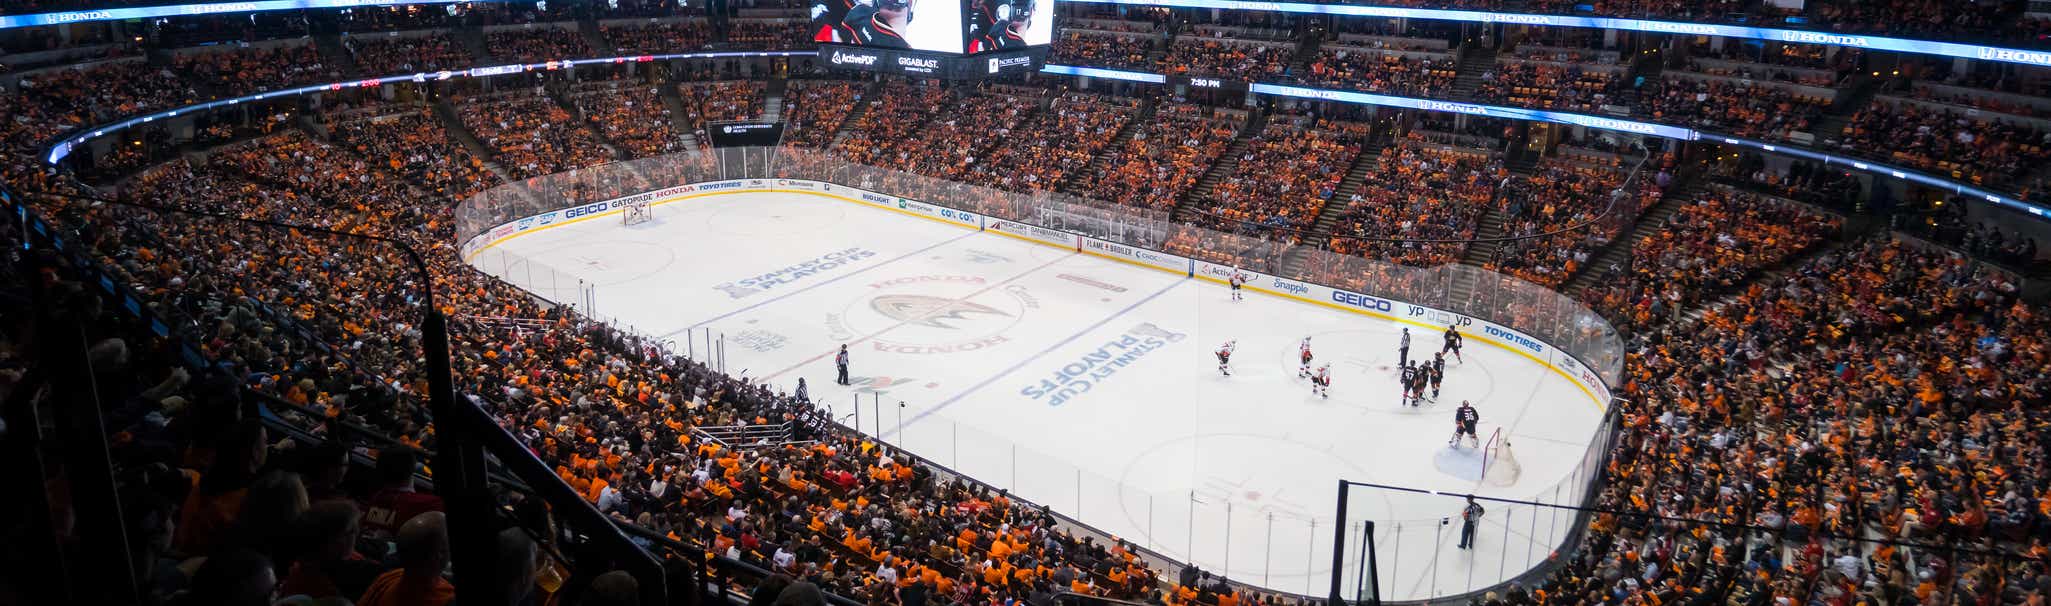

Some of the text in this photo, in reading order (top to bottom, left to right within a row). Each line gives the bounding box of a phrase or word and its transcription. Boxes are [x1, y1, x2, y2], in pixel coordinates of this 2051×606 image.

[59, 11, 112, 21] HONDA
[1495, 14, 1550, 24] HONDA
[1653, 22, 1717, 33] HONDA
[1800, 33, 1868, 46] HONDA
[1208, 79, 1220, 88] PM
[1432, 101, 1489, 114] HONDA
[1594, 120, 1657, 133] HONDA
[656, 186, 695, 198] HONDA
[874, 195, 889, 204] LIGHT
[565, 202, 607, 219] GEICO
[1087, 239, 1132, 255] FLAME BROILER
[739, 247, 860, 286] STANLEY CUP
[758, 250, 876, 289] PLAYOFFS
[1273, 278, 1309, 294] Snapple
[1332, 290, 1392, 312] GEICO
[1408, 304, 1425, 318] yp
[1455, 314, 1472, 327] yp
[873, 336, 1008, 354] HONDA
[1484, 325, 1543, 352] TOYO TIRES
[1021, 334, 1139, 400] PLAYOFFS
[1048, 337, 1165, 406] STANLEY CUP
